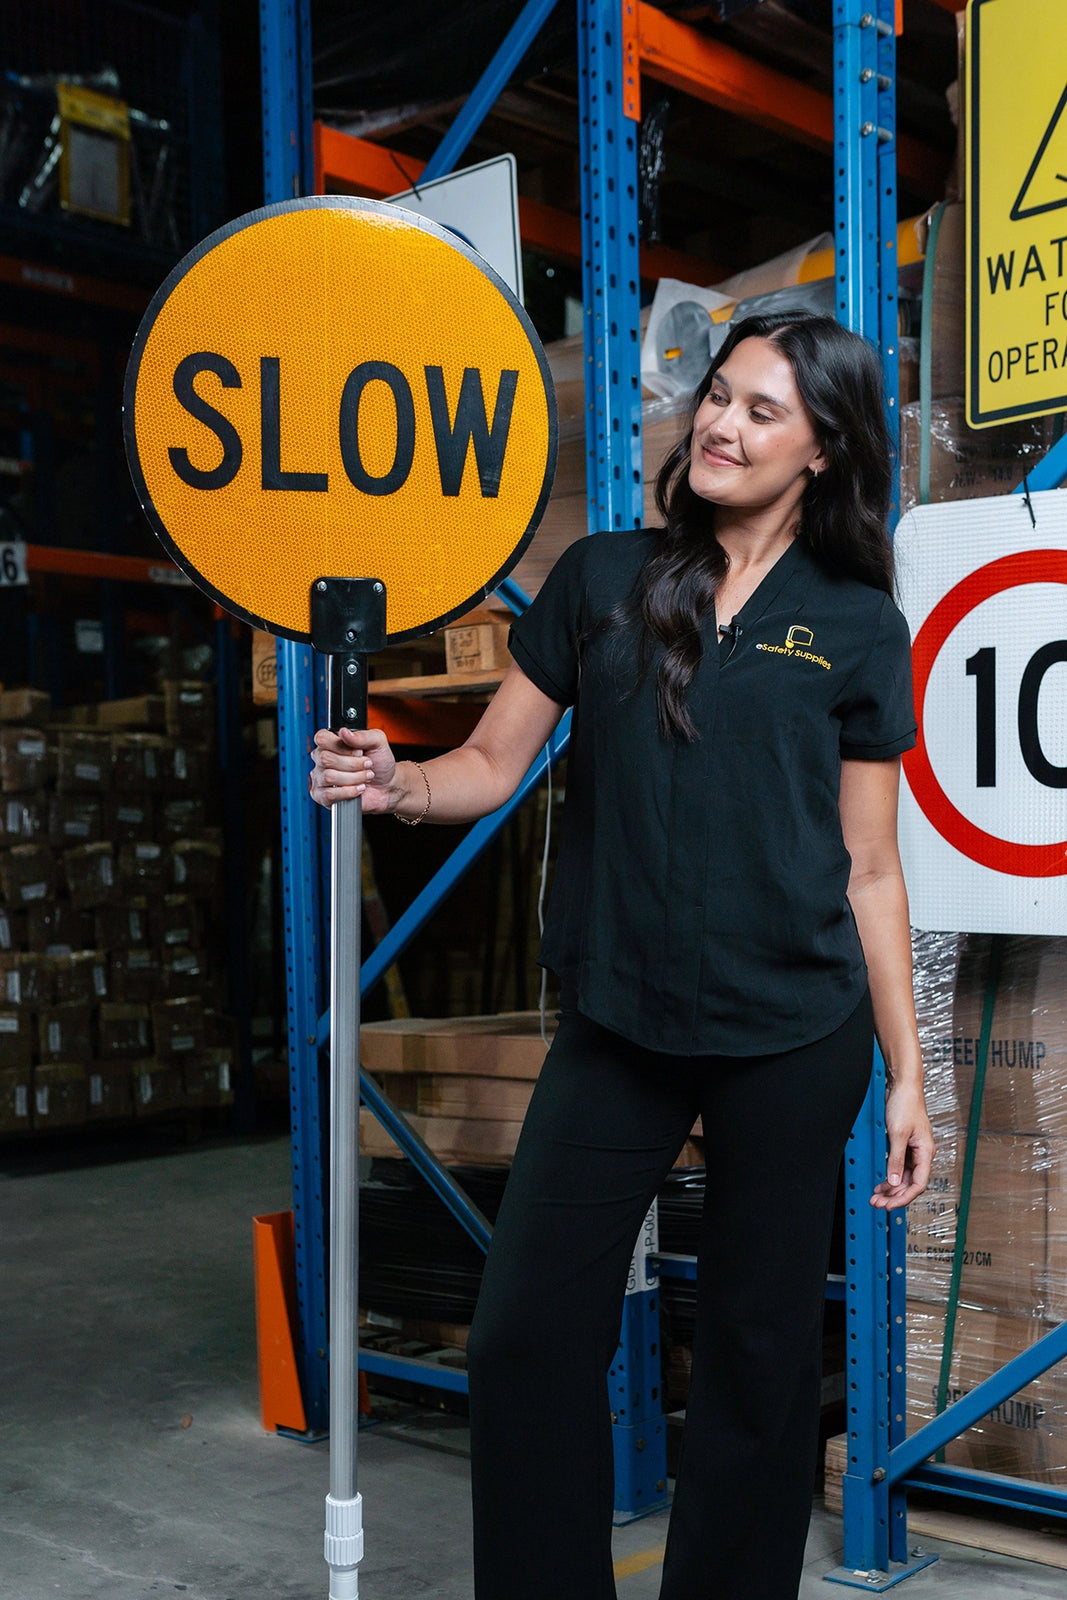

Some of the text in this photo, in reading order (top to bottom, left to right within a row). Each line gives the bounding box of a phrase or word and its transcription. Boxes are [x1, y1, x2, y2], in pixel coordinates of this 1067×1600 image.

[168, 351, 519, 498] SLOW
[756, 643, 832, 670] eSafety Supplies
[991, 1040, 1046, 1070] HUMP
